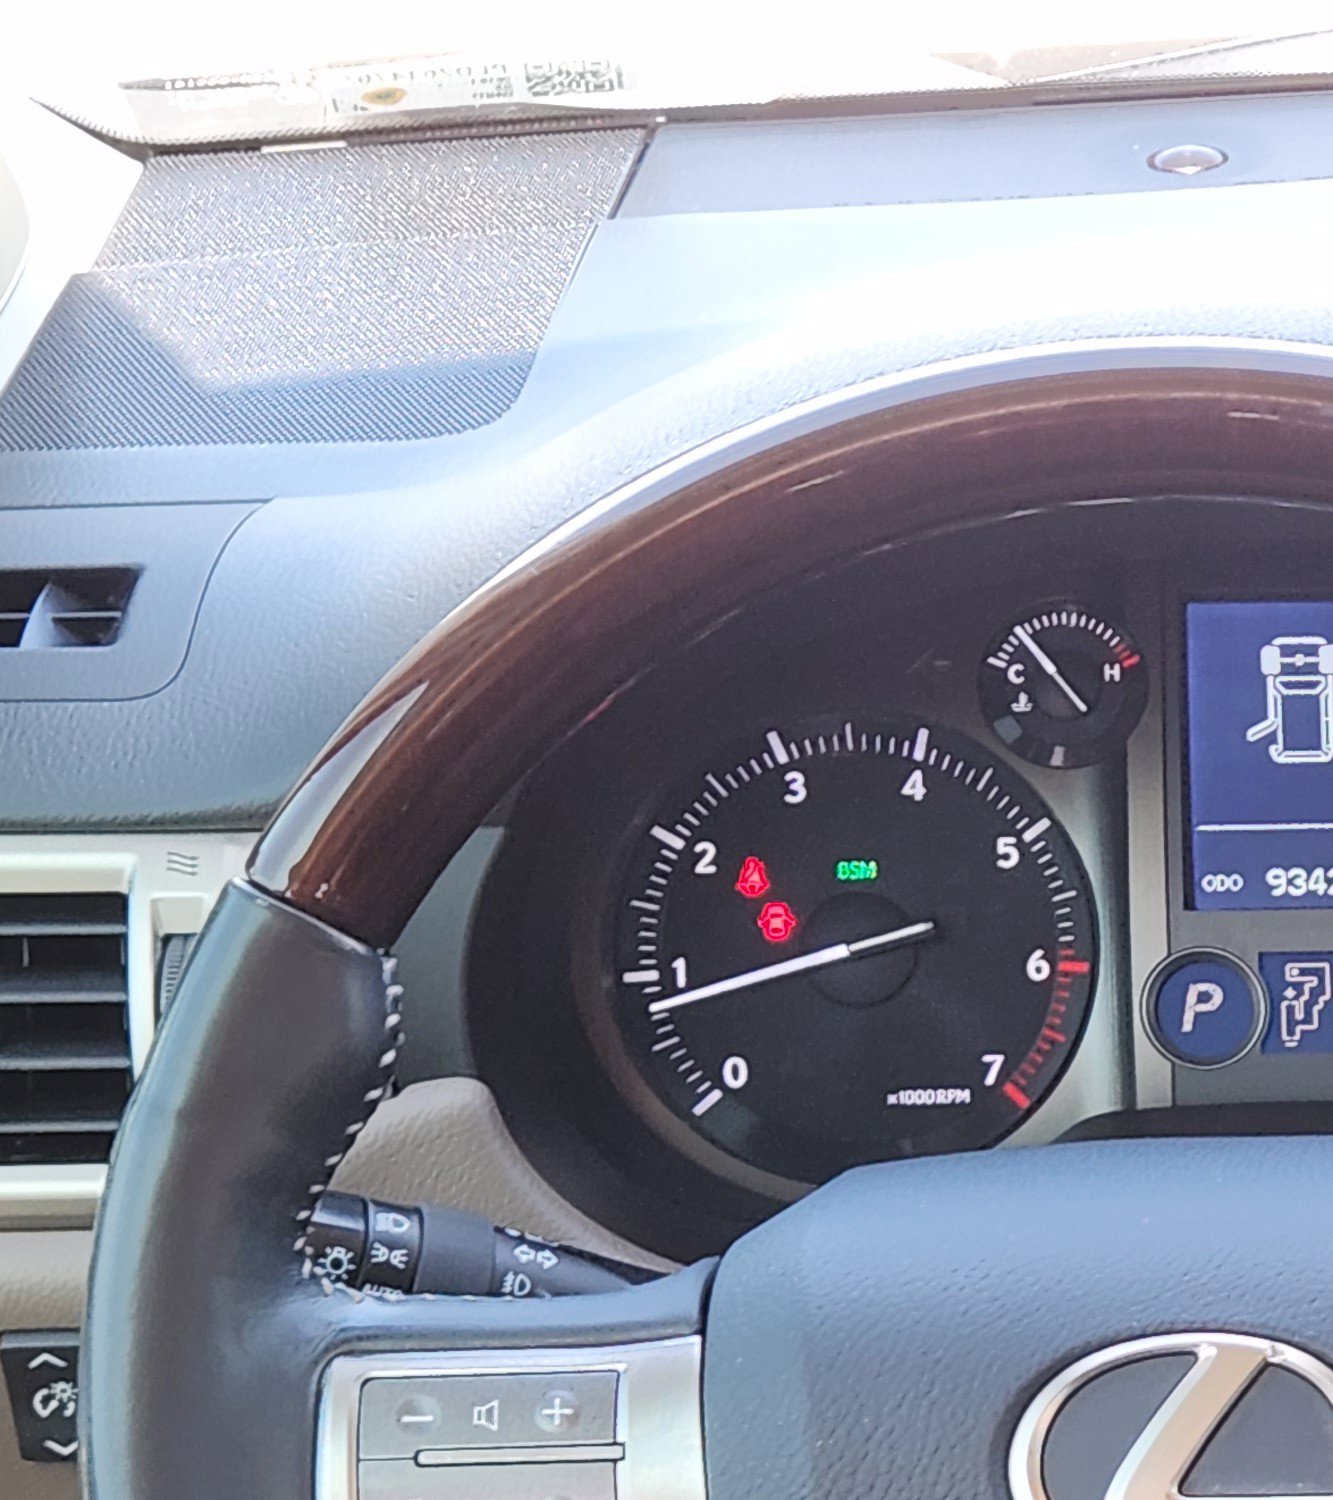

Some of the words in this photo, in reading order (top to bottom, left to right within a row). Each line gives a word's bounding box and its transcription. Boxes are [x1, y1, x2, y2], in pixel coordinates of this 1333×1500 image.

[1008, 664, 1025, 684] C
[1104, 665, 1121, 682] H
[785, 772, 807, 803] 3
[901, 770, 927, 801] 4
[694, 843, 718, 875] 2
[996, 837, 1019, 868] 5
[837, 860, 878, 882] BSM
[1201, 873, 1244, 893] ODO
[671, 957, 687, 987] 1
[1026, 950, 1050, 981] 6
[1180, 982, 1224, 1034] P
[723, 1057, 748, 1089] 0
[982, 1055, 1004, 1086] 7
